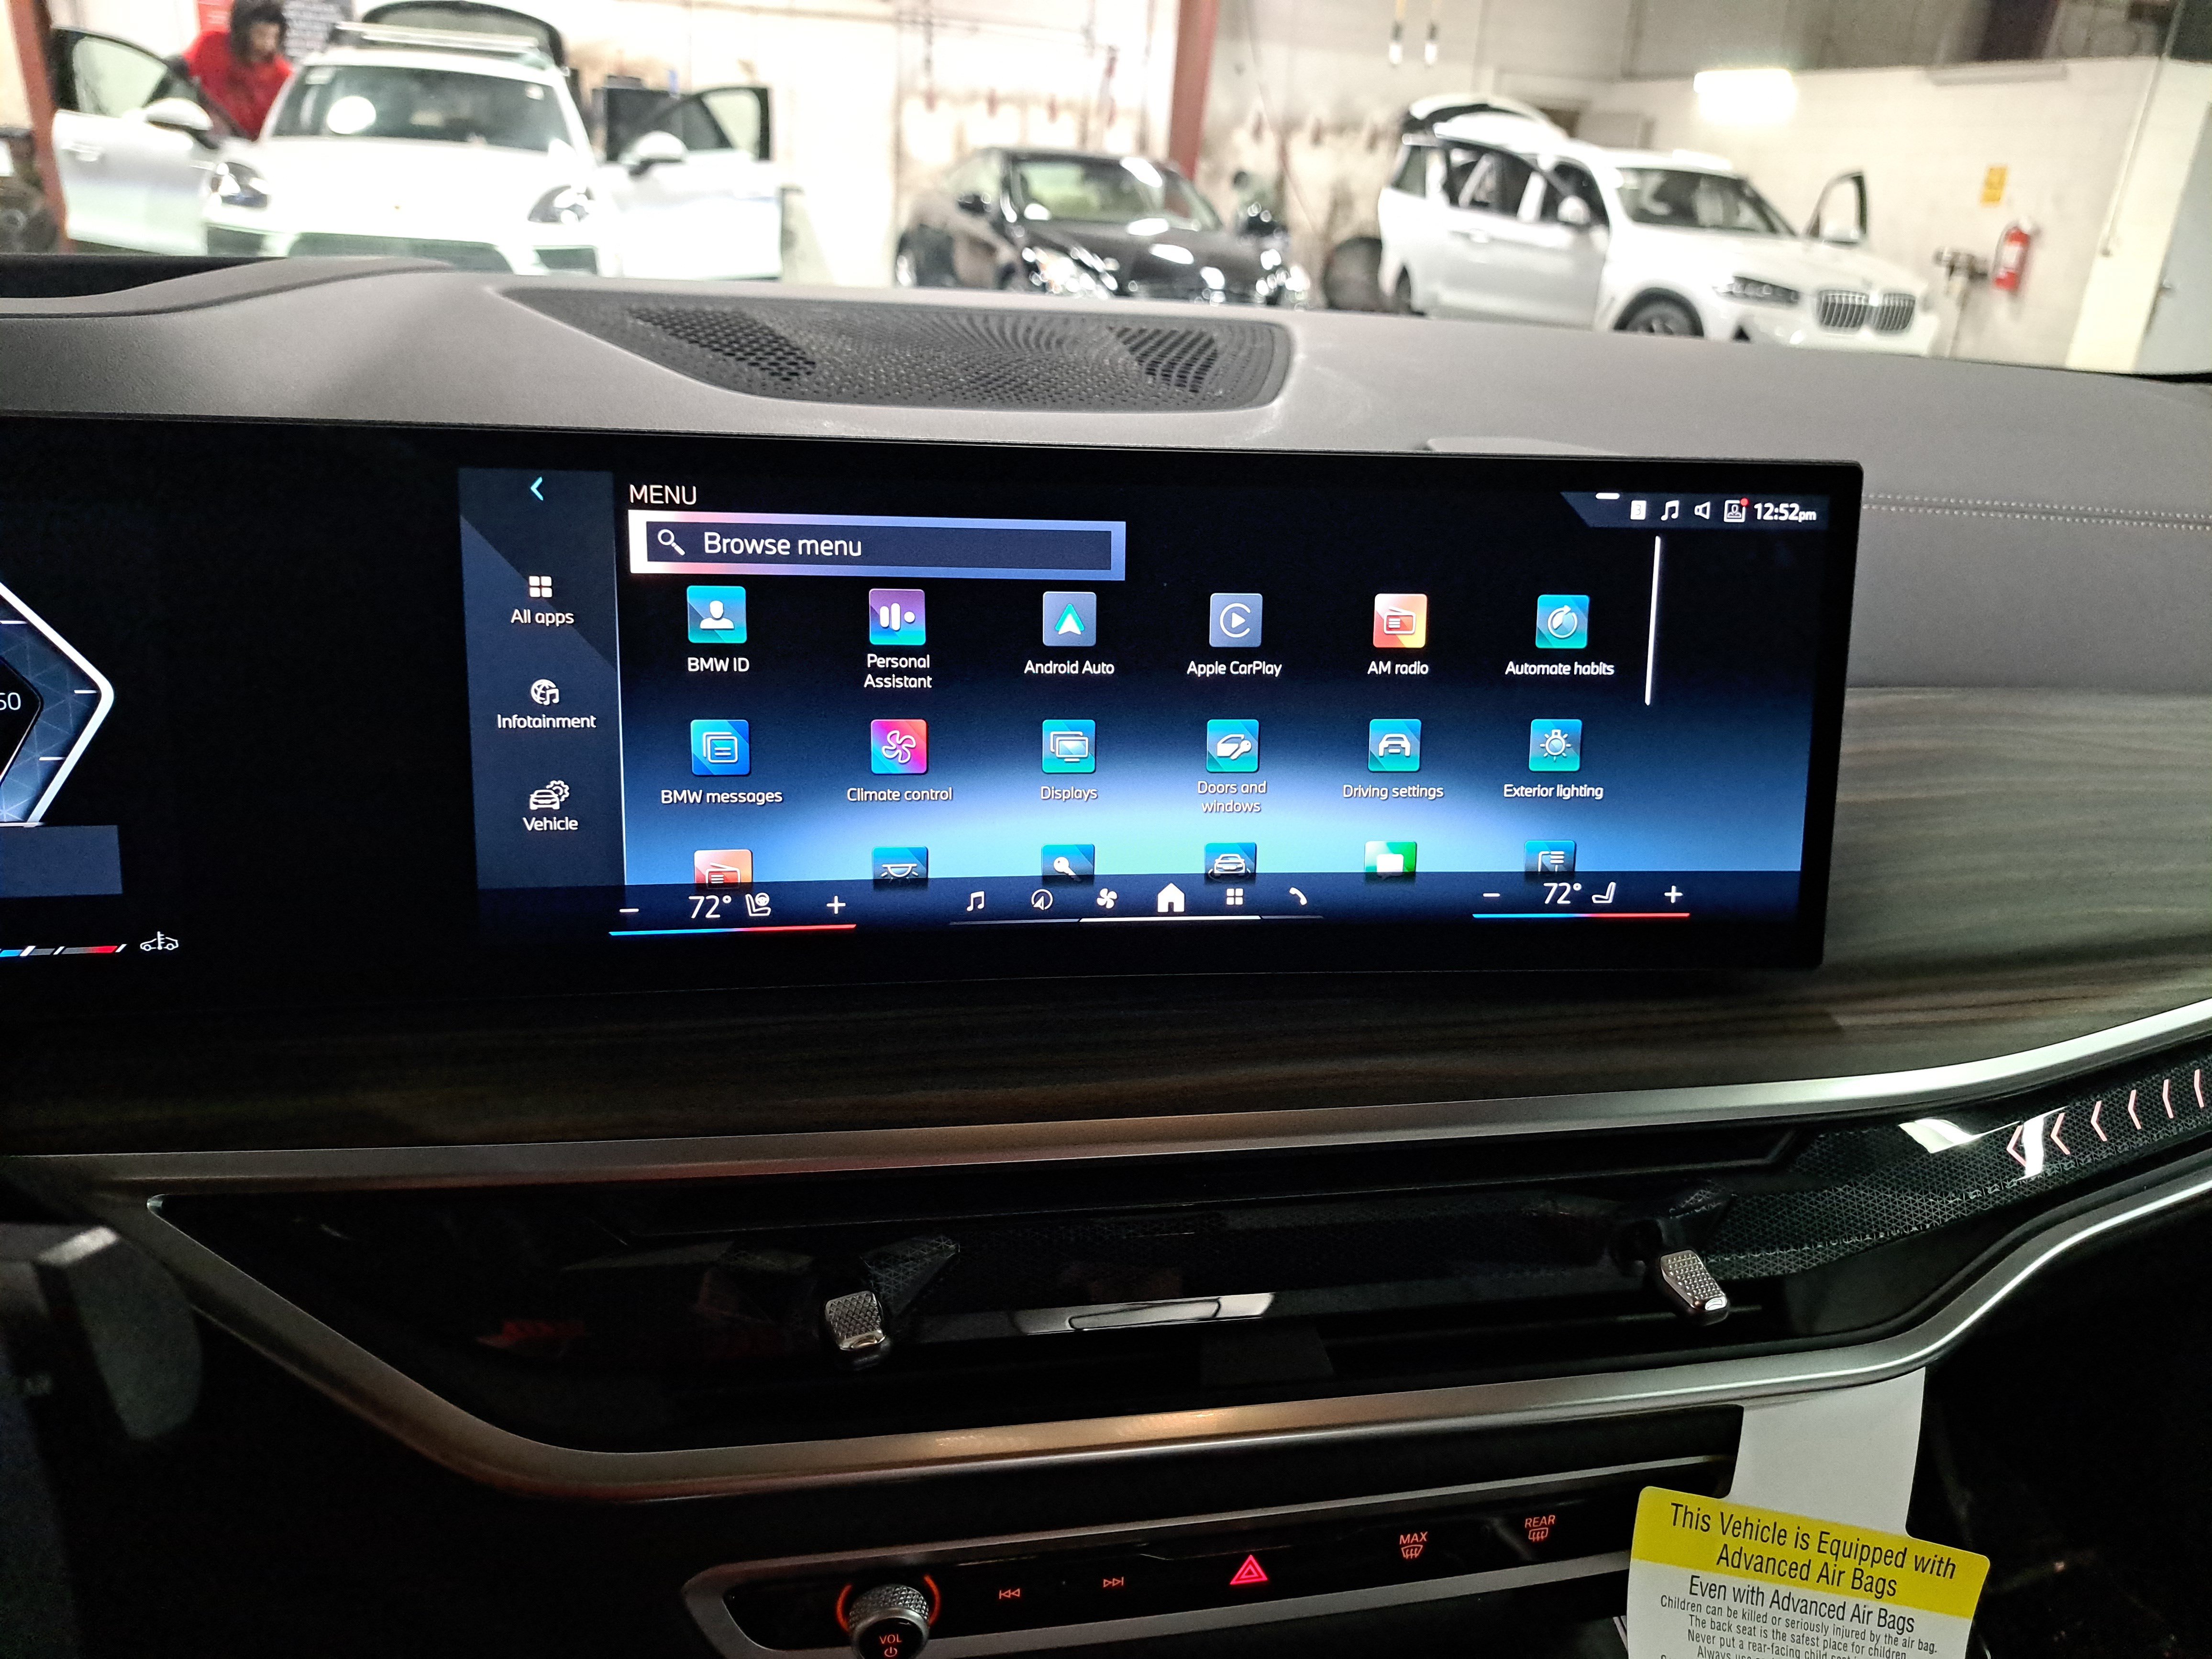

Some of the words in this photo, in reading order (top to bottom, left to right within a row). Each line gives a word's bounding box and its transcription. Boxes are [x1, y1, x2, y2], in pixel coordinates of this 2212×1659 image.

[630, 484, 697, 505] MENU
[1754, 503, 1816, 522] 12:52pm
[704, 531, 790, 555] Browse
[798, 540, 862, 556] menu
[510, 608, 531, 623] All
[535, 611, 574, 627] apps
[687, 657, 728, 671] BMW
[733, 657, 750, 671] ID
[867, 653, 929, 668] Personal
[1024, 660, 1079, 674] Android
[1082, 661, 1115, 675] Auto
[1367, 661, 1392, 675] AM
[1395, 661, 1428, 675] radio
[1187, 661, 1226, 676] Apple
[1229, 661, 1282, 676] CarPlay
[1505, 662, 1571, 675] Automate
[1574, 662, 1614, 675] habits
[863, 674, 932, 688] Assistant
[498, 714, 597, 729] Infotainment
[847, 788, 900, 801] Climate
[904, 787, 952, 801] control
[1040, 786, 1097, 801] Displays
[1197, 781, 1237, 794] Doors
[1241, 780, 1266, 794] and
[1343, 785, 1388, 799] Driving
[1392, 785, 1444, 799] settings
[1504, 784, 1555, 797] Exterior
[1557, 784, 1604, 799] lighting
[661, 790, 702, 804] BMW
[706, 791, 783, 805] messages
[1202, 800, 1261, 813] windows
[523, 817, 578, 831] Vehicle
[1543, 882, 1582, 904] 72°
[688, 895, 731, 918] 72°
[1525, 1515, 1555, 1528] REAR
[1399, 1531, 1428, 1545] MAX
[1671, 1503, 1711, 1532] This
[1720, 1512, 1787, 1546] Vehicle
[1794, 1526, 1810, 1550] is
[1817, 1531, 1907, 1569] Equipped
[1914, 1554, 1956, 1579] with
[1716, 1543, 1812, 1582] Advanced
[1816, 1561, 1845, 1586] Air
[1851, 1567, 1897, 1599] Bags
[1689, 1575, 1726, 1601] Even
[1733, 1584, 1764, 1607] with
[1770, 1589, 1846, 1621] Advanced
[1850, 1604, 1873, 1625] Air
[1877, 1607, 1915, 1635] Bags
[1661, 1595, 1702, 1613] Children
[1706, 1604, 1722, 1616] can
[1727, 1606, 1738, 1619] be
[1742, 1608, 1767, 1624] killed
[1771, 1616, 1781, 1626] or
[1785, 1618, 1829, 1637] seriously
[1833, 1623, 1866, 1640] injured
[1870, 1630, 1881, 1645] by
[1884, 1633, 1898, 1646] the
[1902, 1636, 1915, 1648] air
[1918, 1638, 1937, 1654] bag.
[879, 1634, 902, 1644] VOL
[1689, 1614, 1706, 1628] The
[1710, 1618, 1733, 1633] back
[1736, 1624, 1756, 1637] seat
[1760, 1626, 1768, 1638] is
[1772, 1628, 1786, 1641] the
[1791, 1633, 1819, 1647] safest
[1823, 1637, 1847, 1652] place
[1852, 1641, 1865, 1655] for
[1688, 1629, 1716, 1645] Never
[1720, 1637, 1735, 1648] put
[1738, 1640, 1744, 1649] a
[1748, 1642, 1800, 1659] rear-facing
